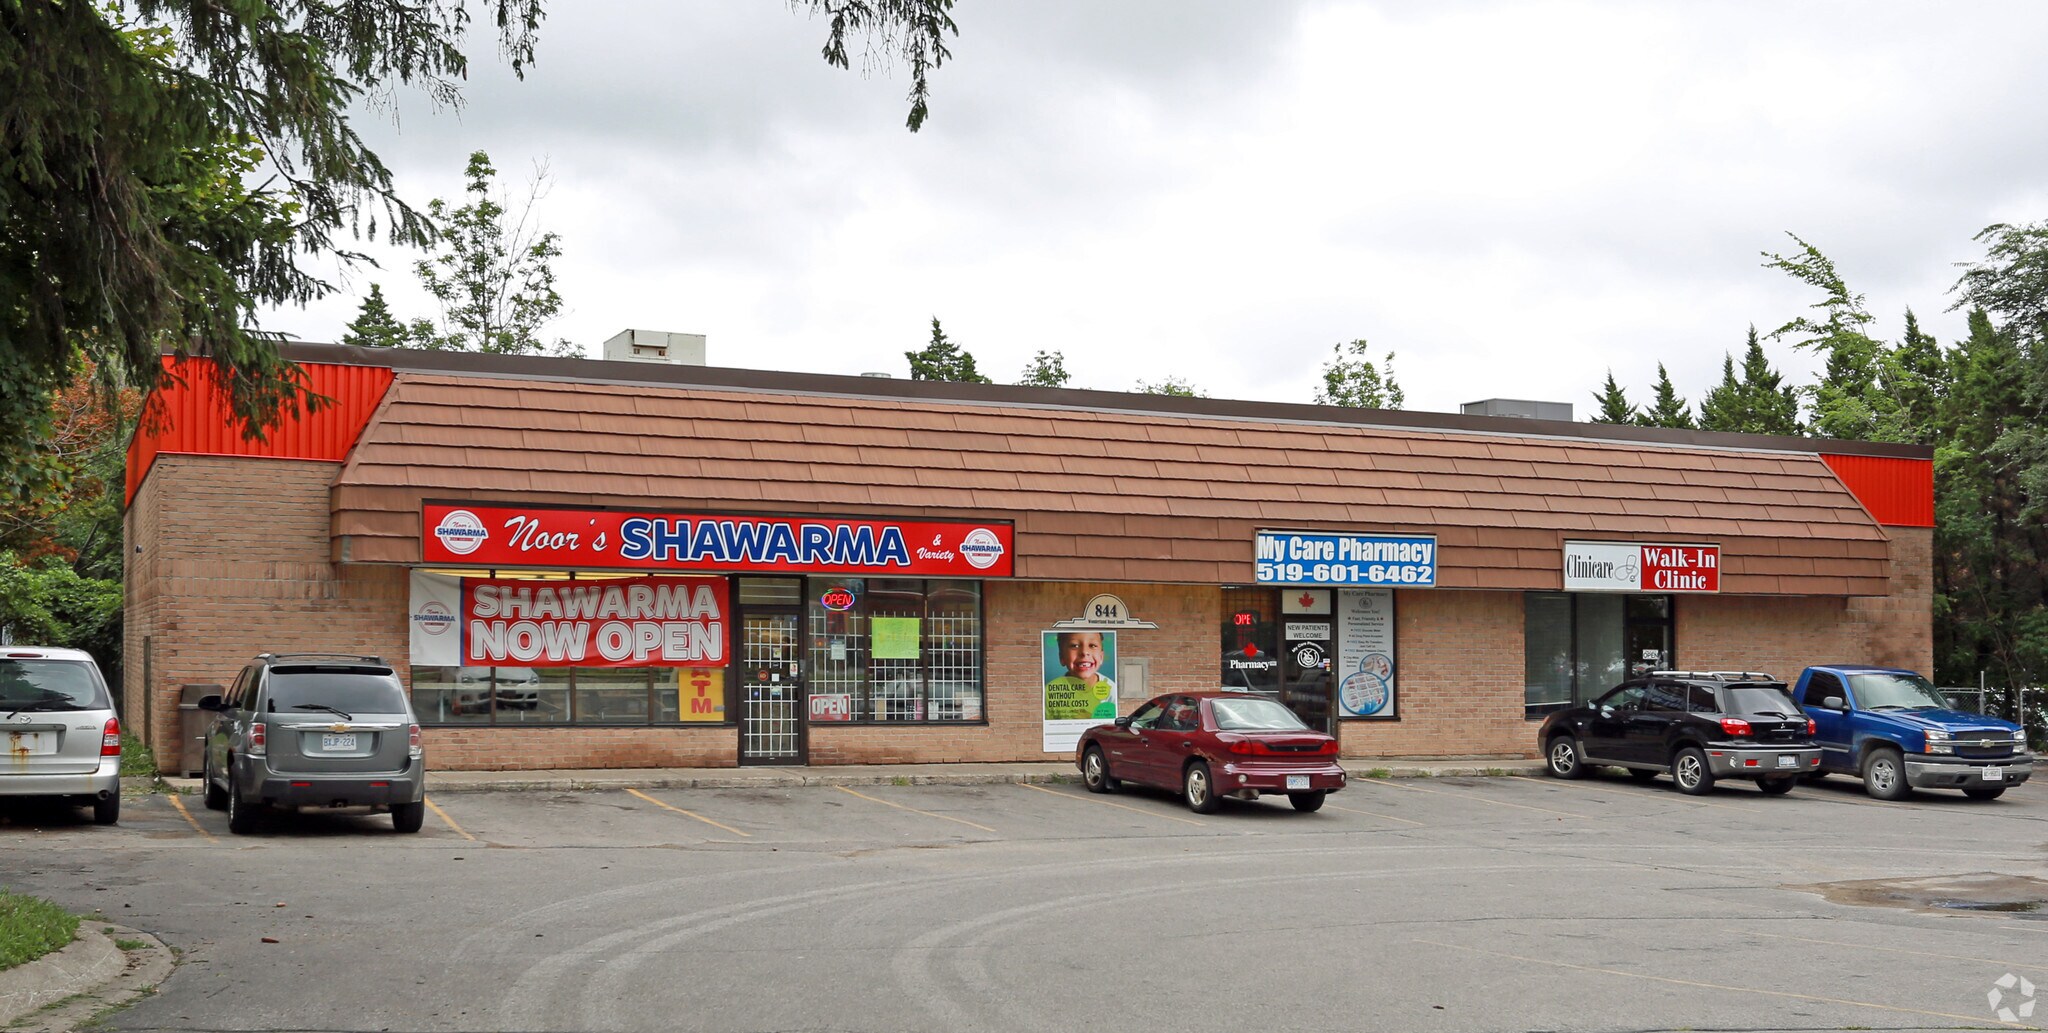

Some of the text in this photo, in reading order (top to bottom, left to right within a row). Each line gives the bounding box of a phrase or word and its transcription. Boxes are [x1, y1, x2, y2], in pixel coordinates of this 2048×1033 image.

[437, 527, 486, 537] SHAWARMA
[504, 515, 911, 567] Noor's SHAWARMA
[932, 534, 942, 546] &
[916, 547, 955, 563] Variety
[961, 544, 1002, 553] SHAWARMA
[1257, 536, 1432, 565] My Care Pharmacy
[1643, 548, 1716, 568] Walk-In
[1257, 563, 1432, 583] 519-601-6462
[1566, 554, 1614, 579] Clinicare
[1654, 569, 1707, 589] Clinic
[472, 584, 719, 620] SHAWARMA
[824, 593, 852, 606] OPEN
[413, 614, 456, 622] SHAWARMA
[1095, 604, 1117, 618] 844
[471, 620, 723, 661] NOW OPEN
[1643, 650, 1658, 659] OPEN
[1230, 659, 1270, 671] Pharmacy
[1071, 683, 1086, 691] CARE
[1048, 692, 1075, 700] WITHOUT
[812, 698, 848, 715] OPEN
